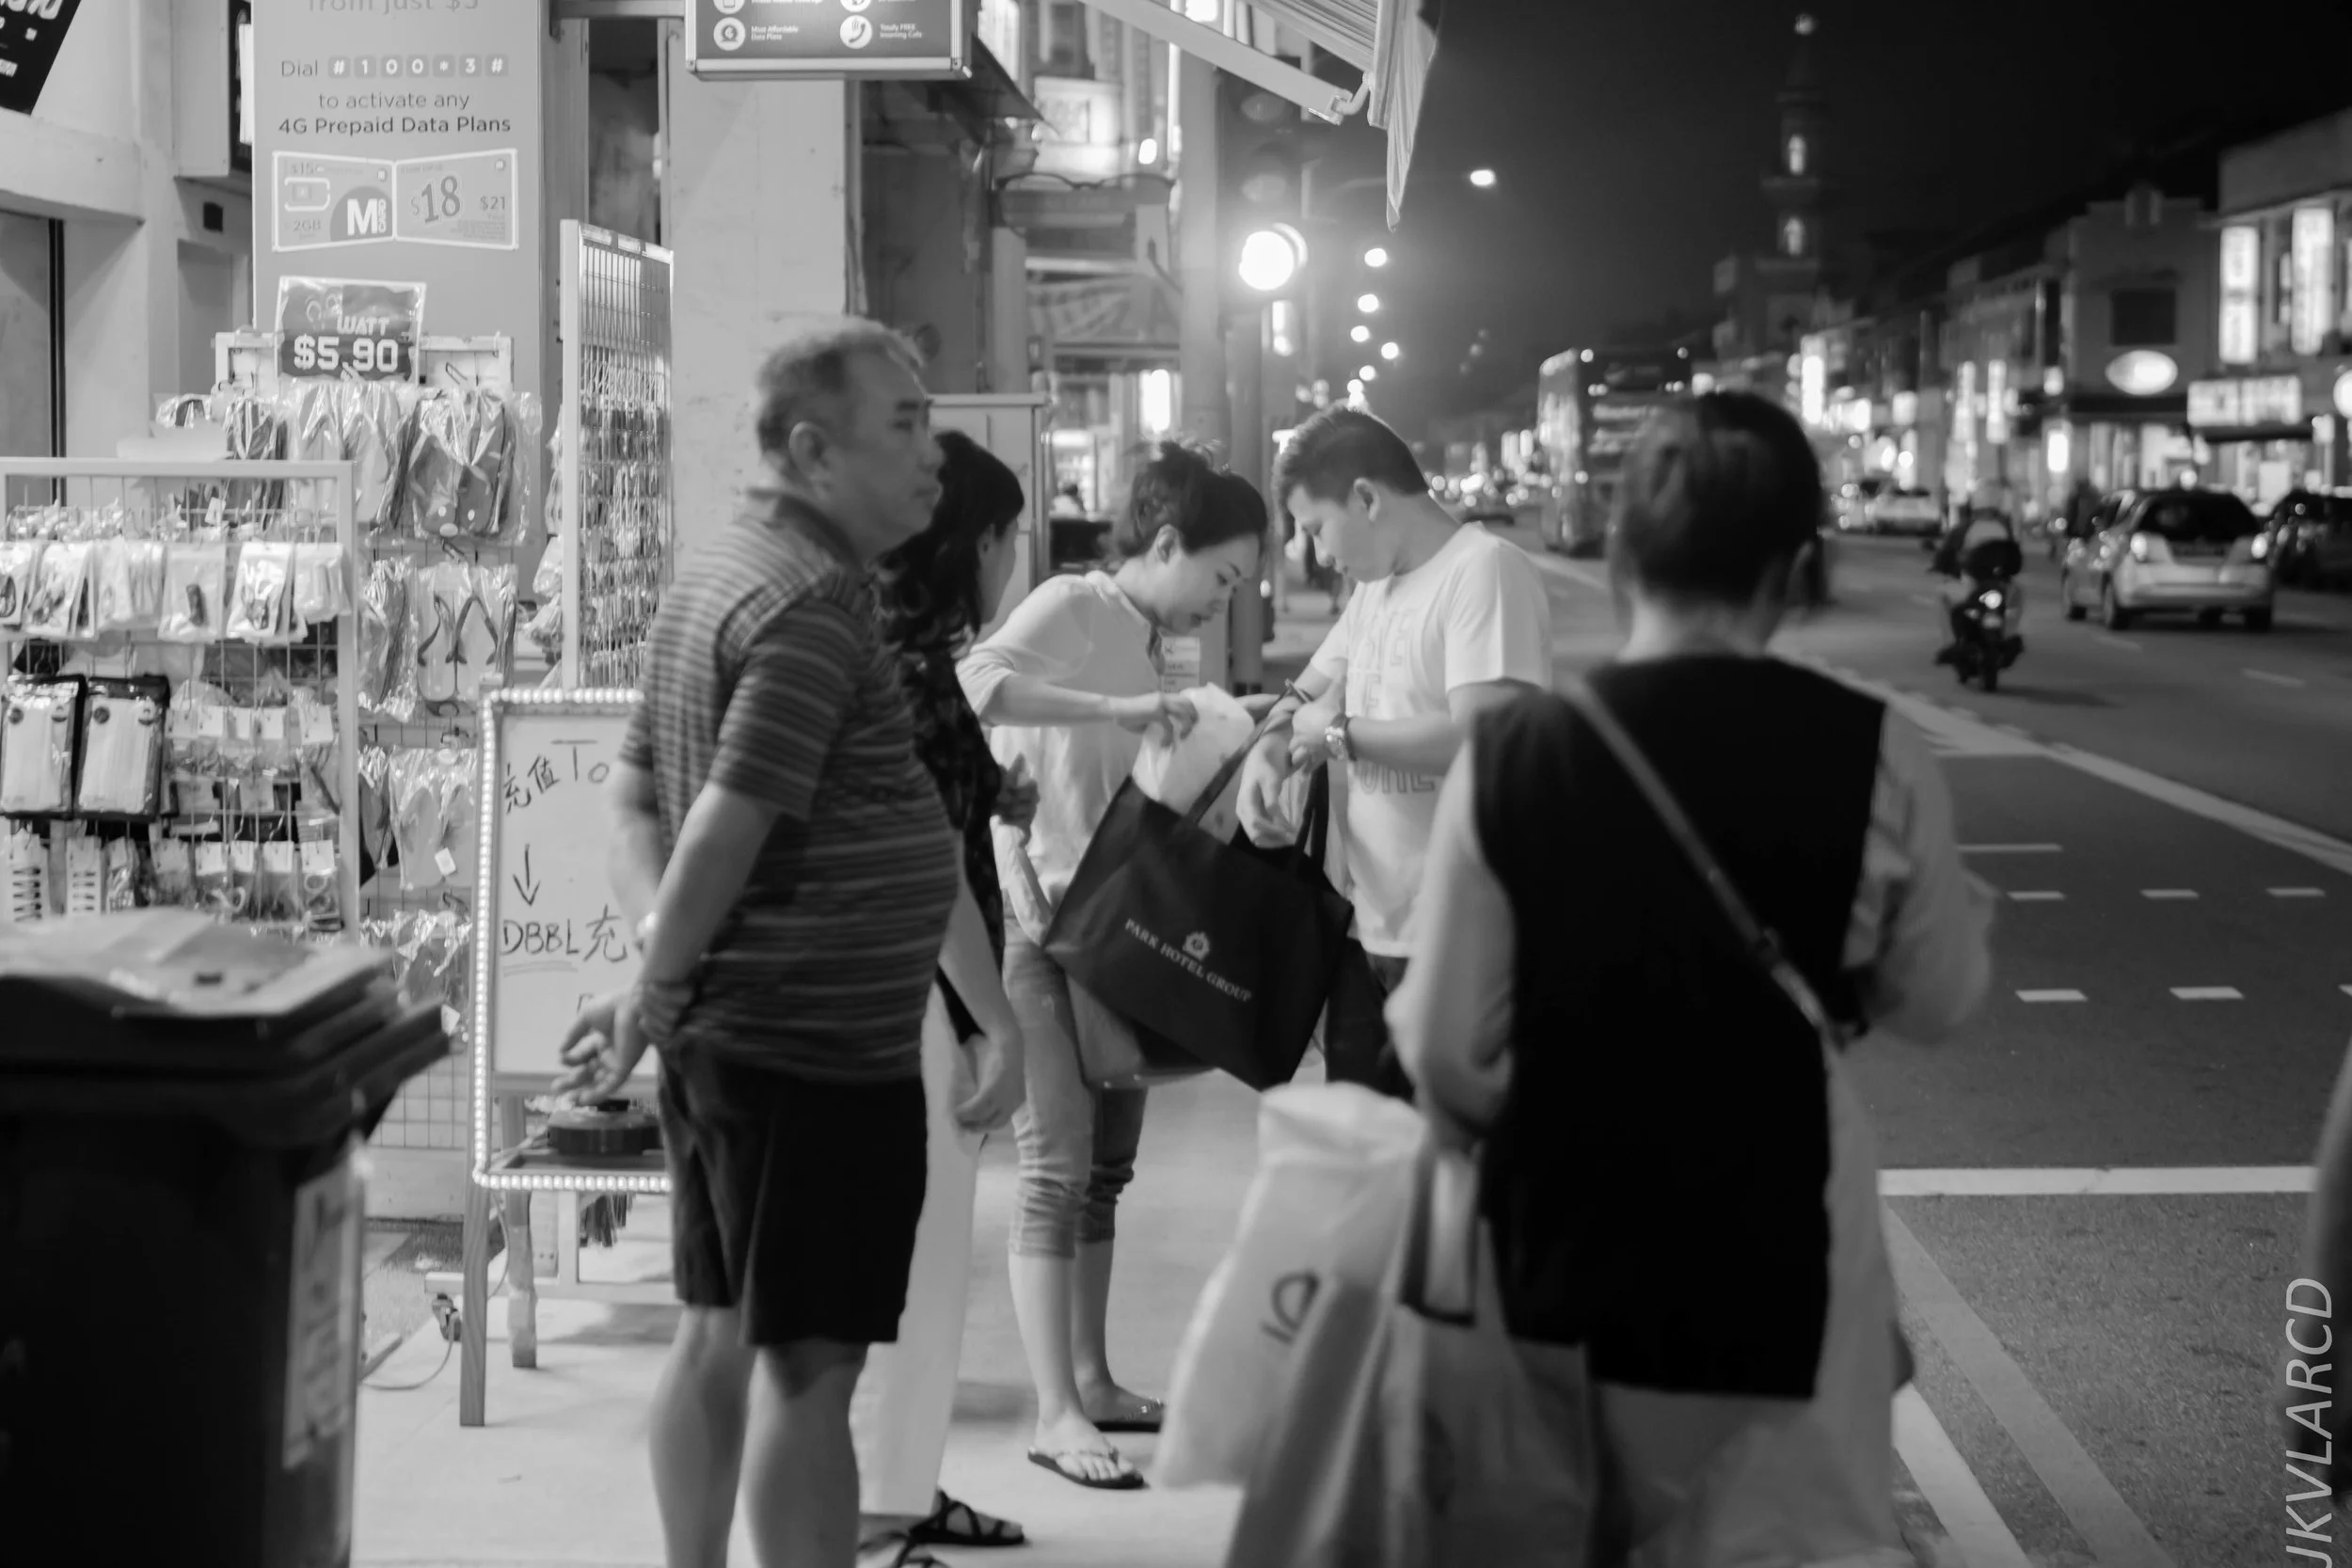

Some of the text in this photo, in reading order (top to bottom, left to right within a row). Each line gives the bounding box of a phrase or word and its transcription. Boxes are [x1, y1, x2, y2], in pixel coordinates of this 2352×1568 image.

[281, 59, 318, 77] Dial
[319, 92, 470, 111] to activate any
[278, 116, 511, 136] 4G Prepaid Data Plans
[480, 195, 506, 212] $21
[336, 315, 389, 336] WATT
[1125, 918, 1252, 1003] PARK HOTEL GROUP
